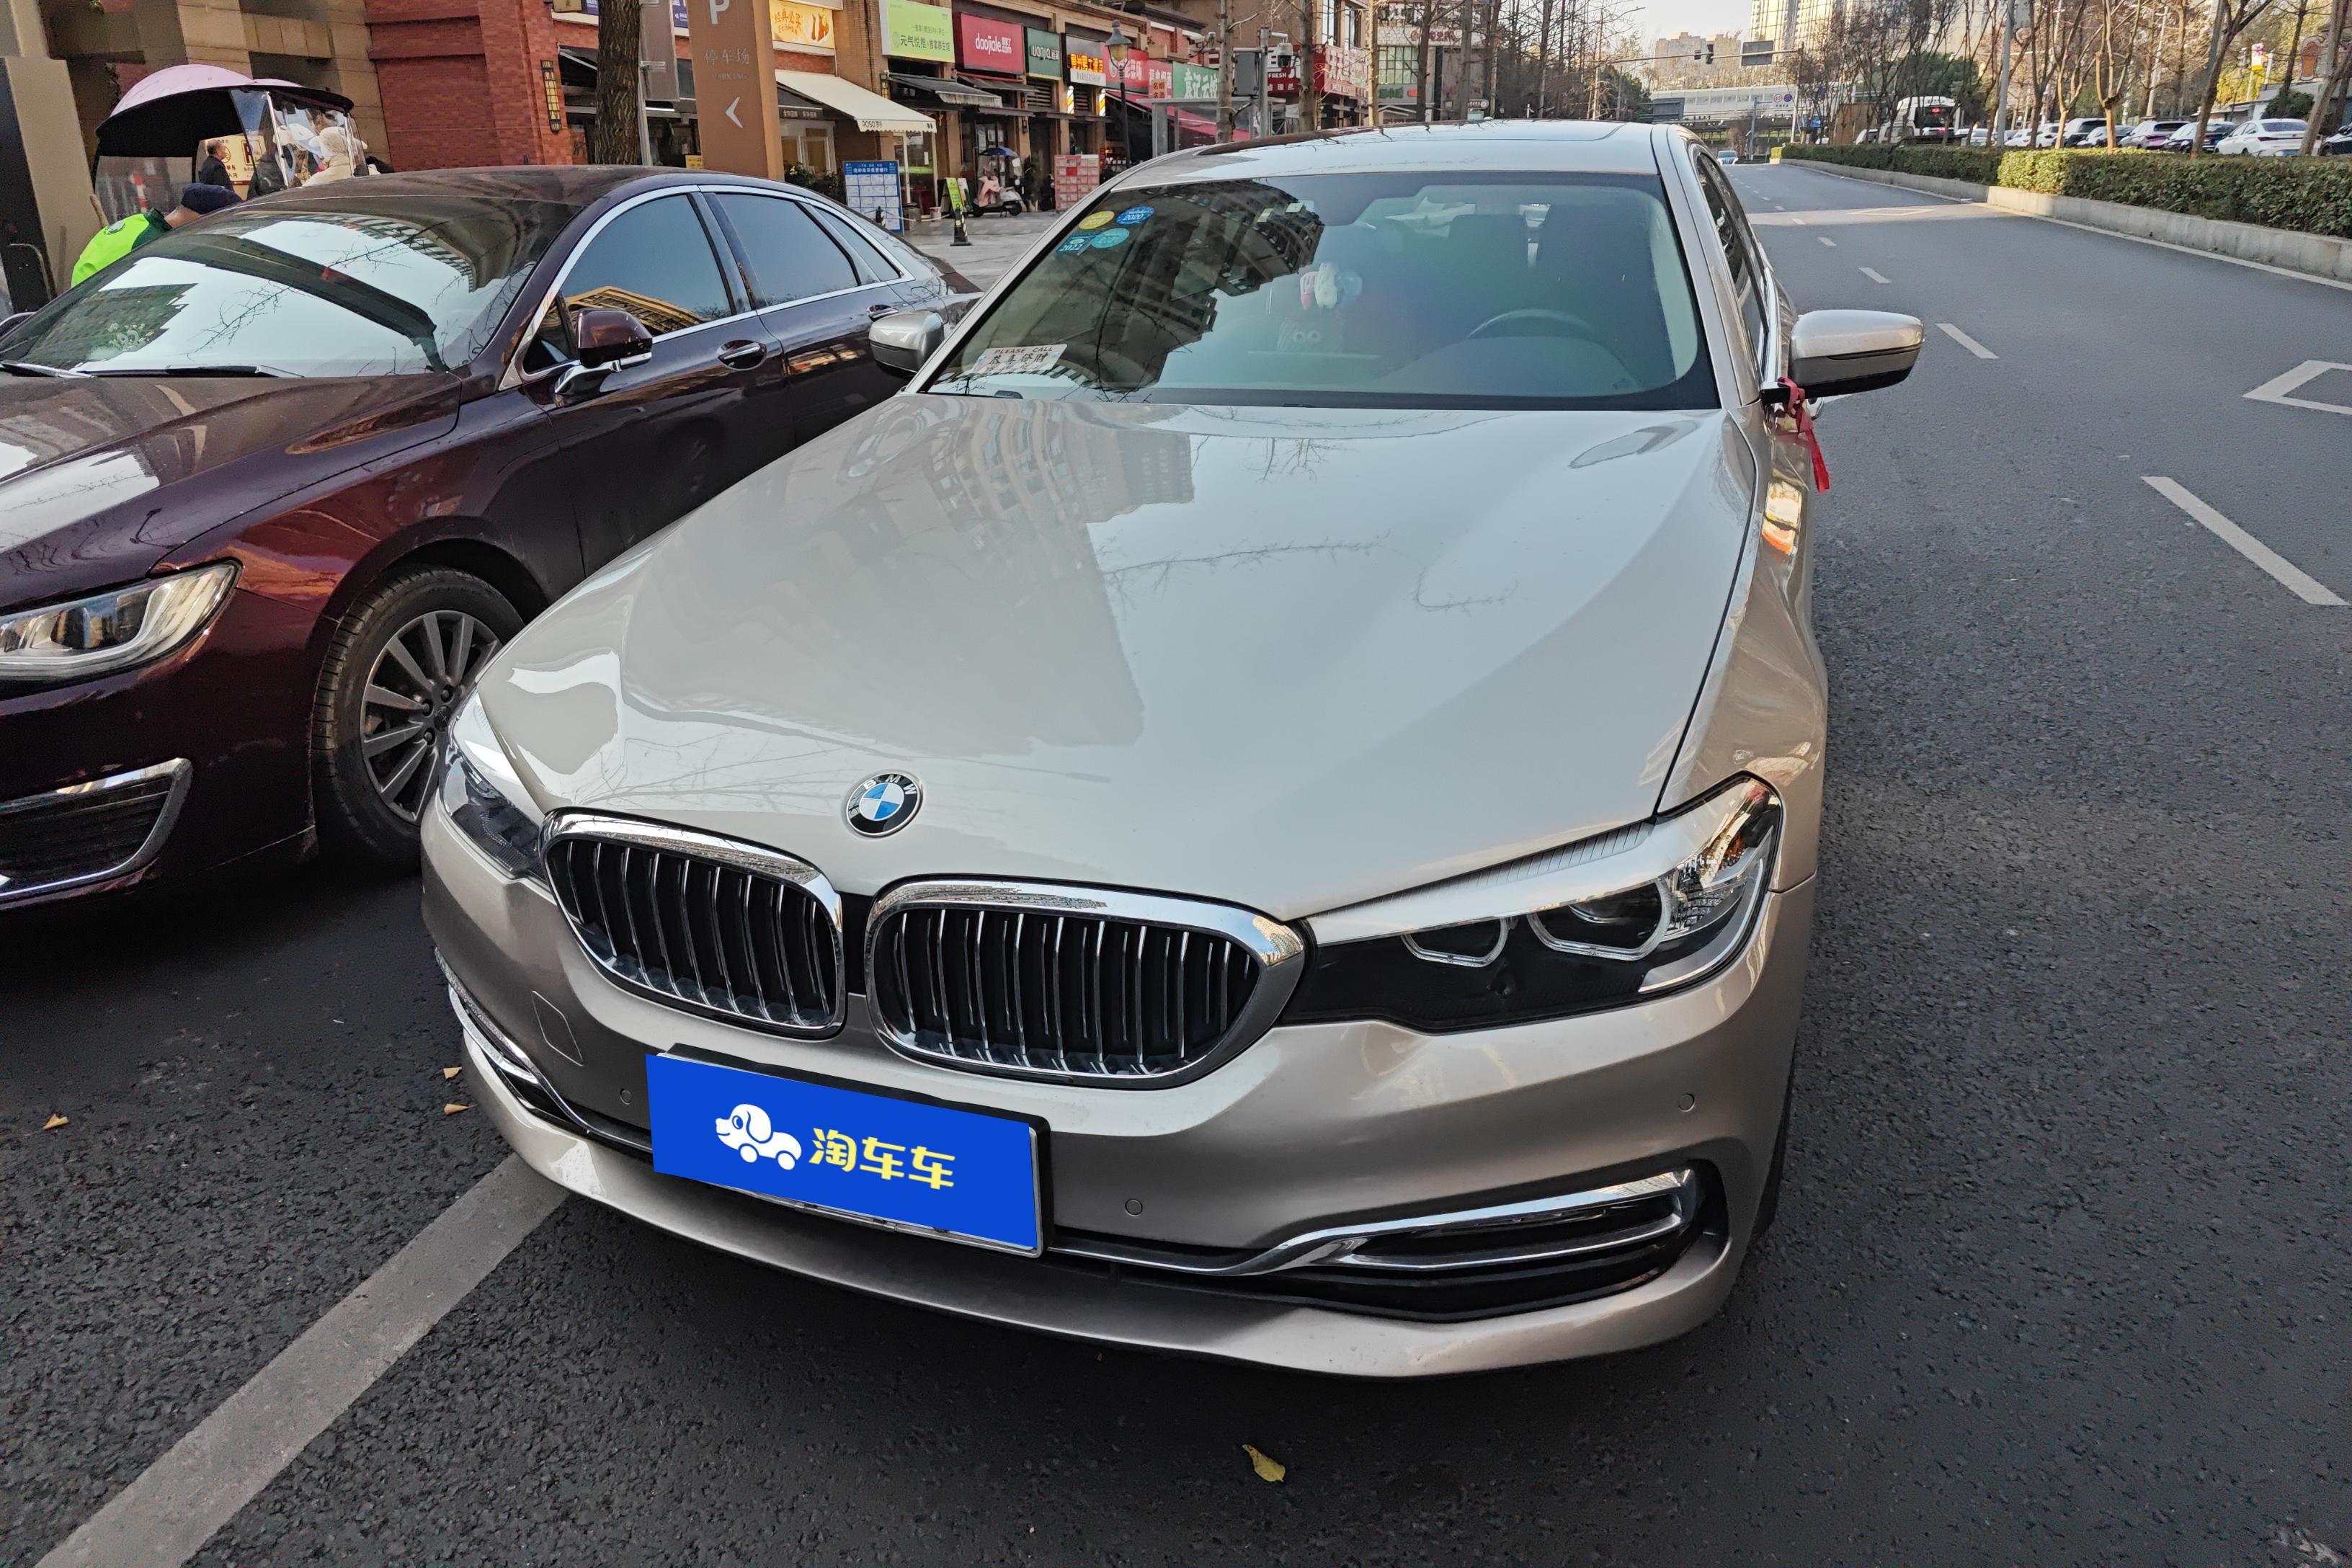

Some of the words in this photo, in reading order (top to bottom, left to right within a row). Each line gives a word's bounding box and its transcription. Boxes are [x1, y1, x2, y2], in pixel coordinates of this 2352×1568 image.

[705, 48, 749, 66] 停车场
[863, 774, 917, 795] BMW
